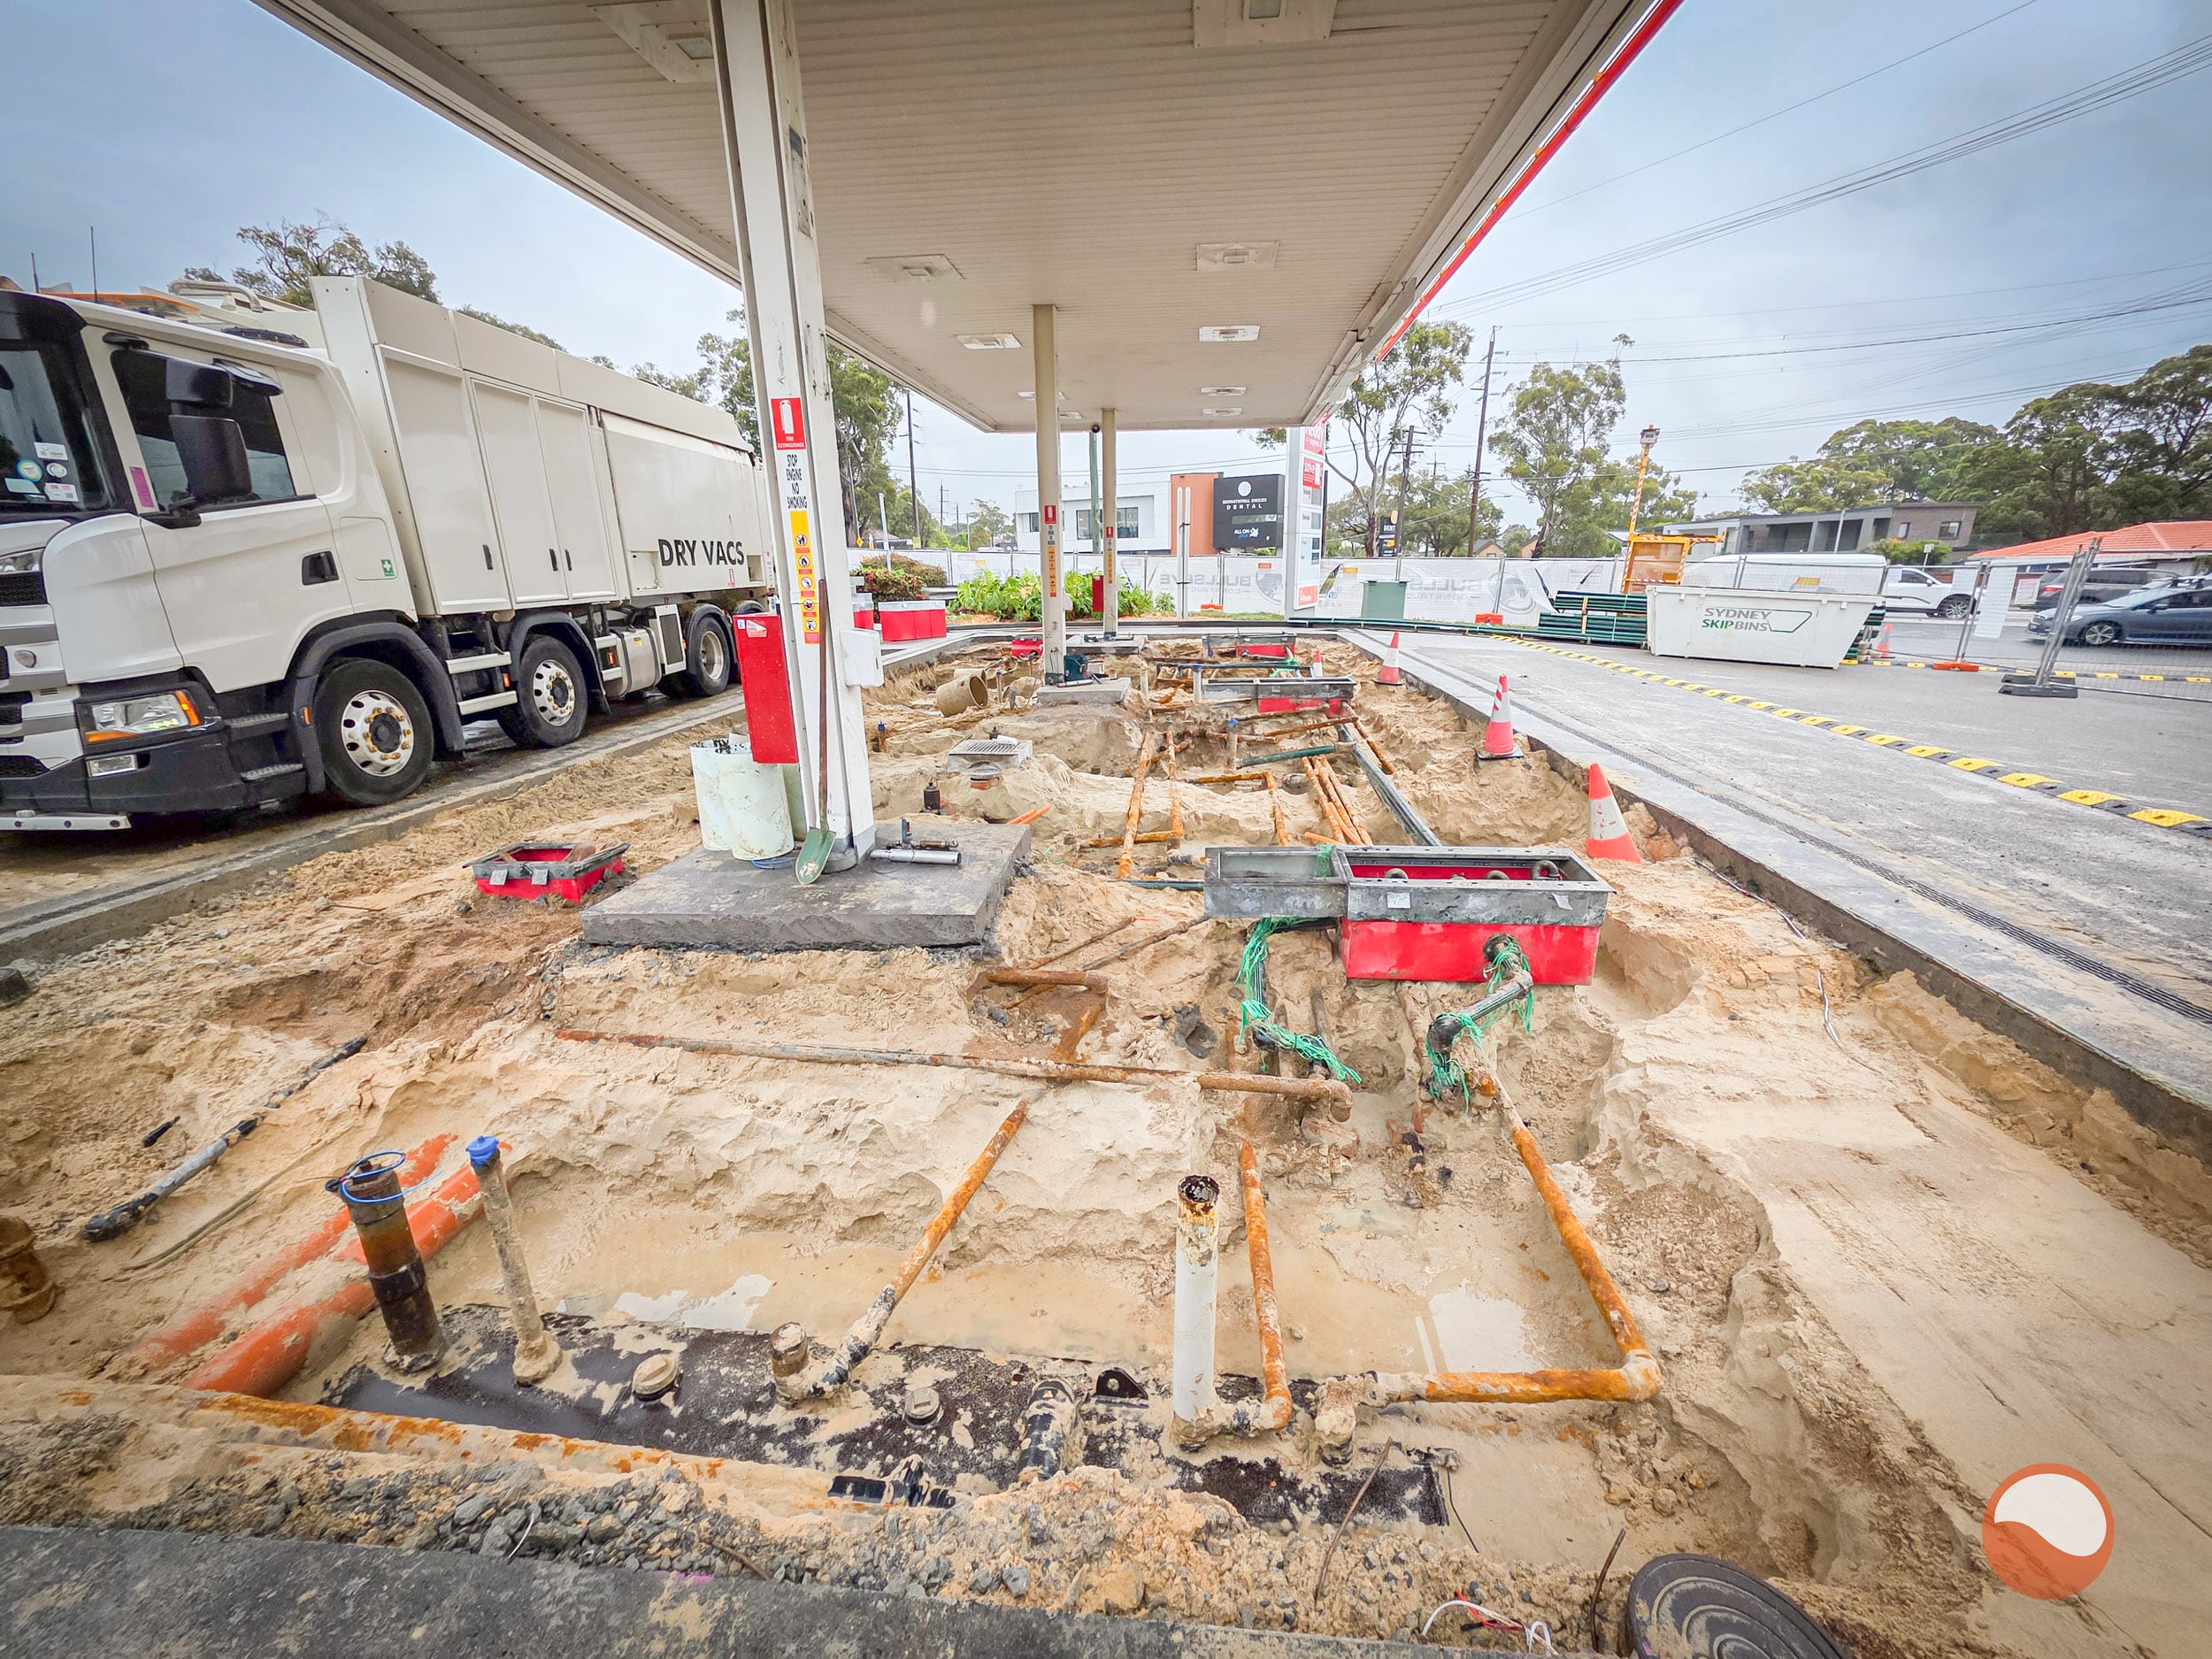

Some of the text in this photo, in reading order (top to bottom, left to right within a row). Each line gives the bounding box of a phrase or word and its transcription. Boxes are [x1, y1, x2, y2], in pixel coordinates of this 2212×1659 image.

[787, 454, 797, 467] STOP
[786, 468, 803, 481] ENGINE
[791, 482, 800, 495] NO
[787, 495, 808, 509] SMOKING
[658, 539, 745, 566] DRY VACS
[1704, 608, 1771, 619] SYDNEY
